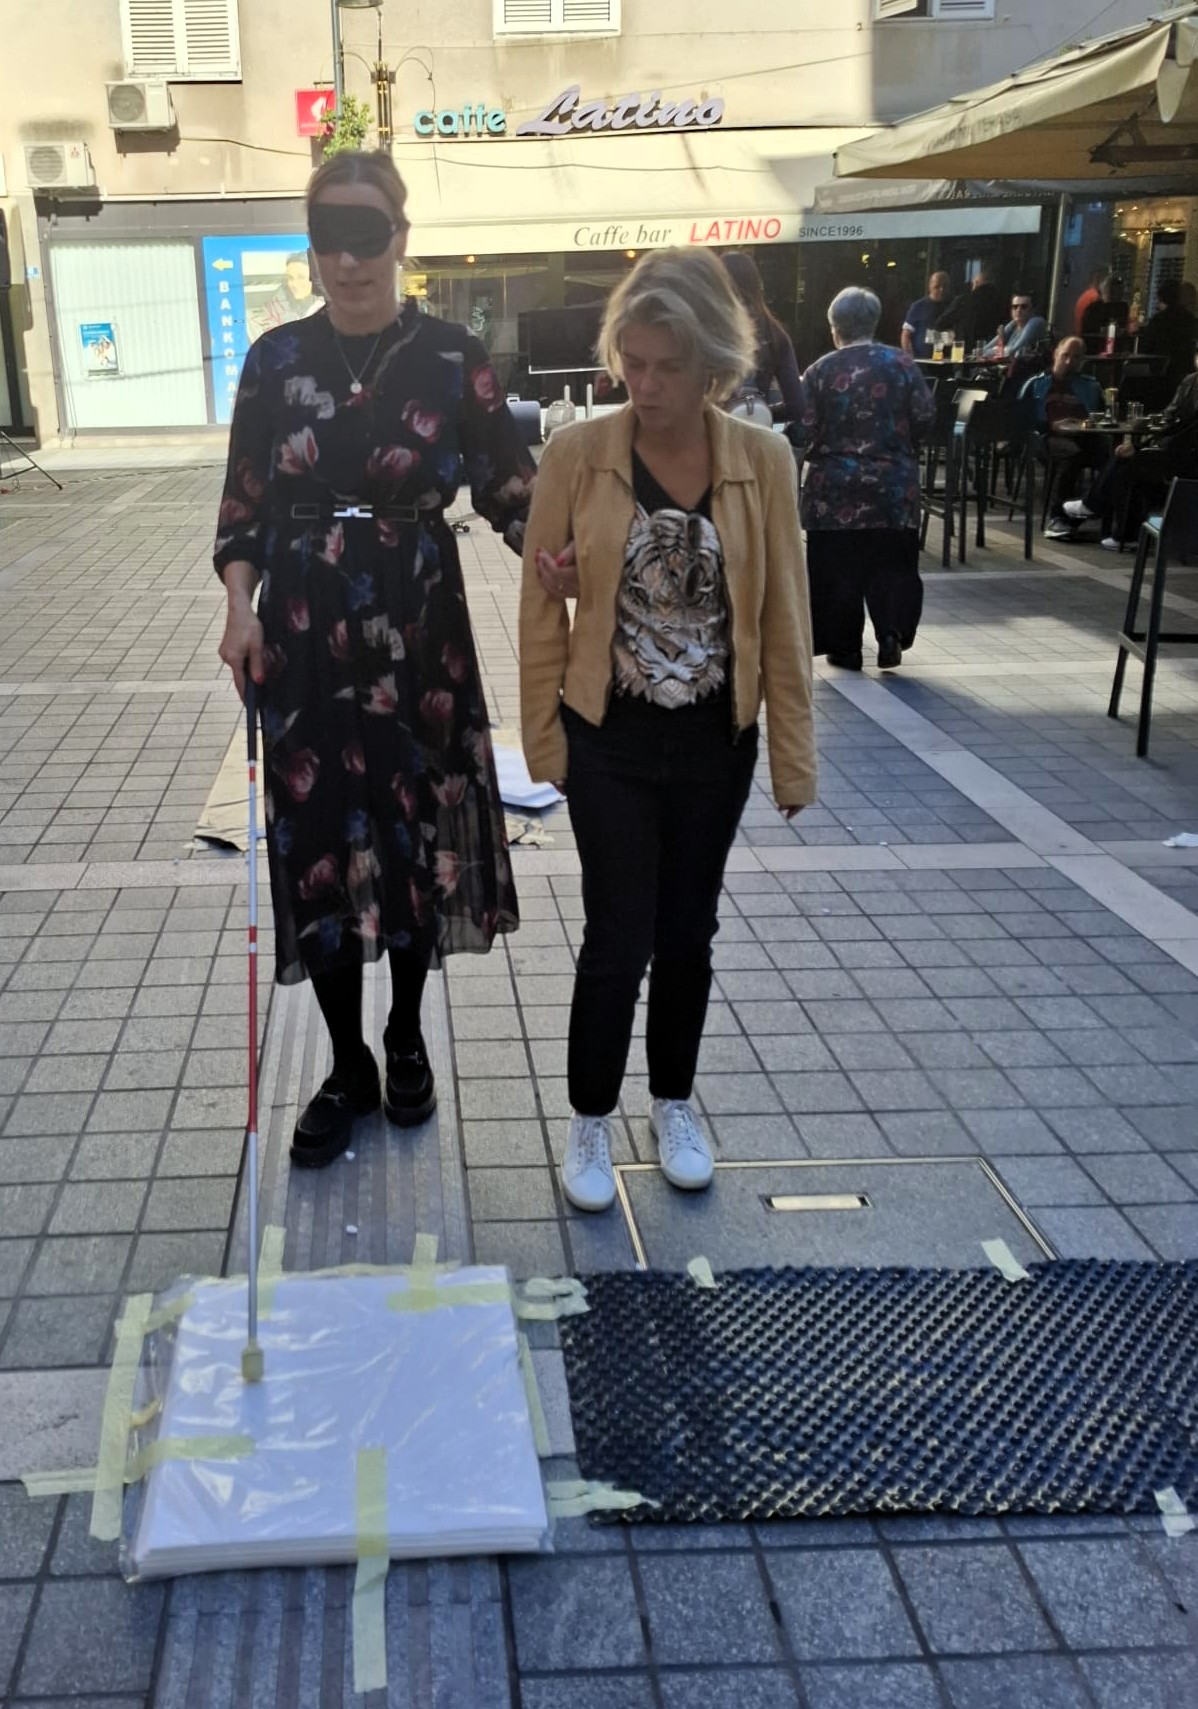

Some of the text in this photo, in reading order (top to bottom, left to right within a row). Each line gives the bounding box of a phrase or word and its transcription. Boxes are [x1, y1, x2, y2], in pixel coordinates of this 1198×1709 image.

[413, 85, 725, 137] caffe Latino
[574, 218, 782, 246] Caffe bar LATINO
